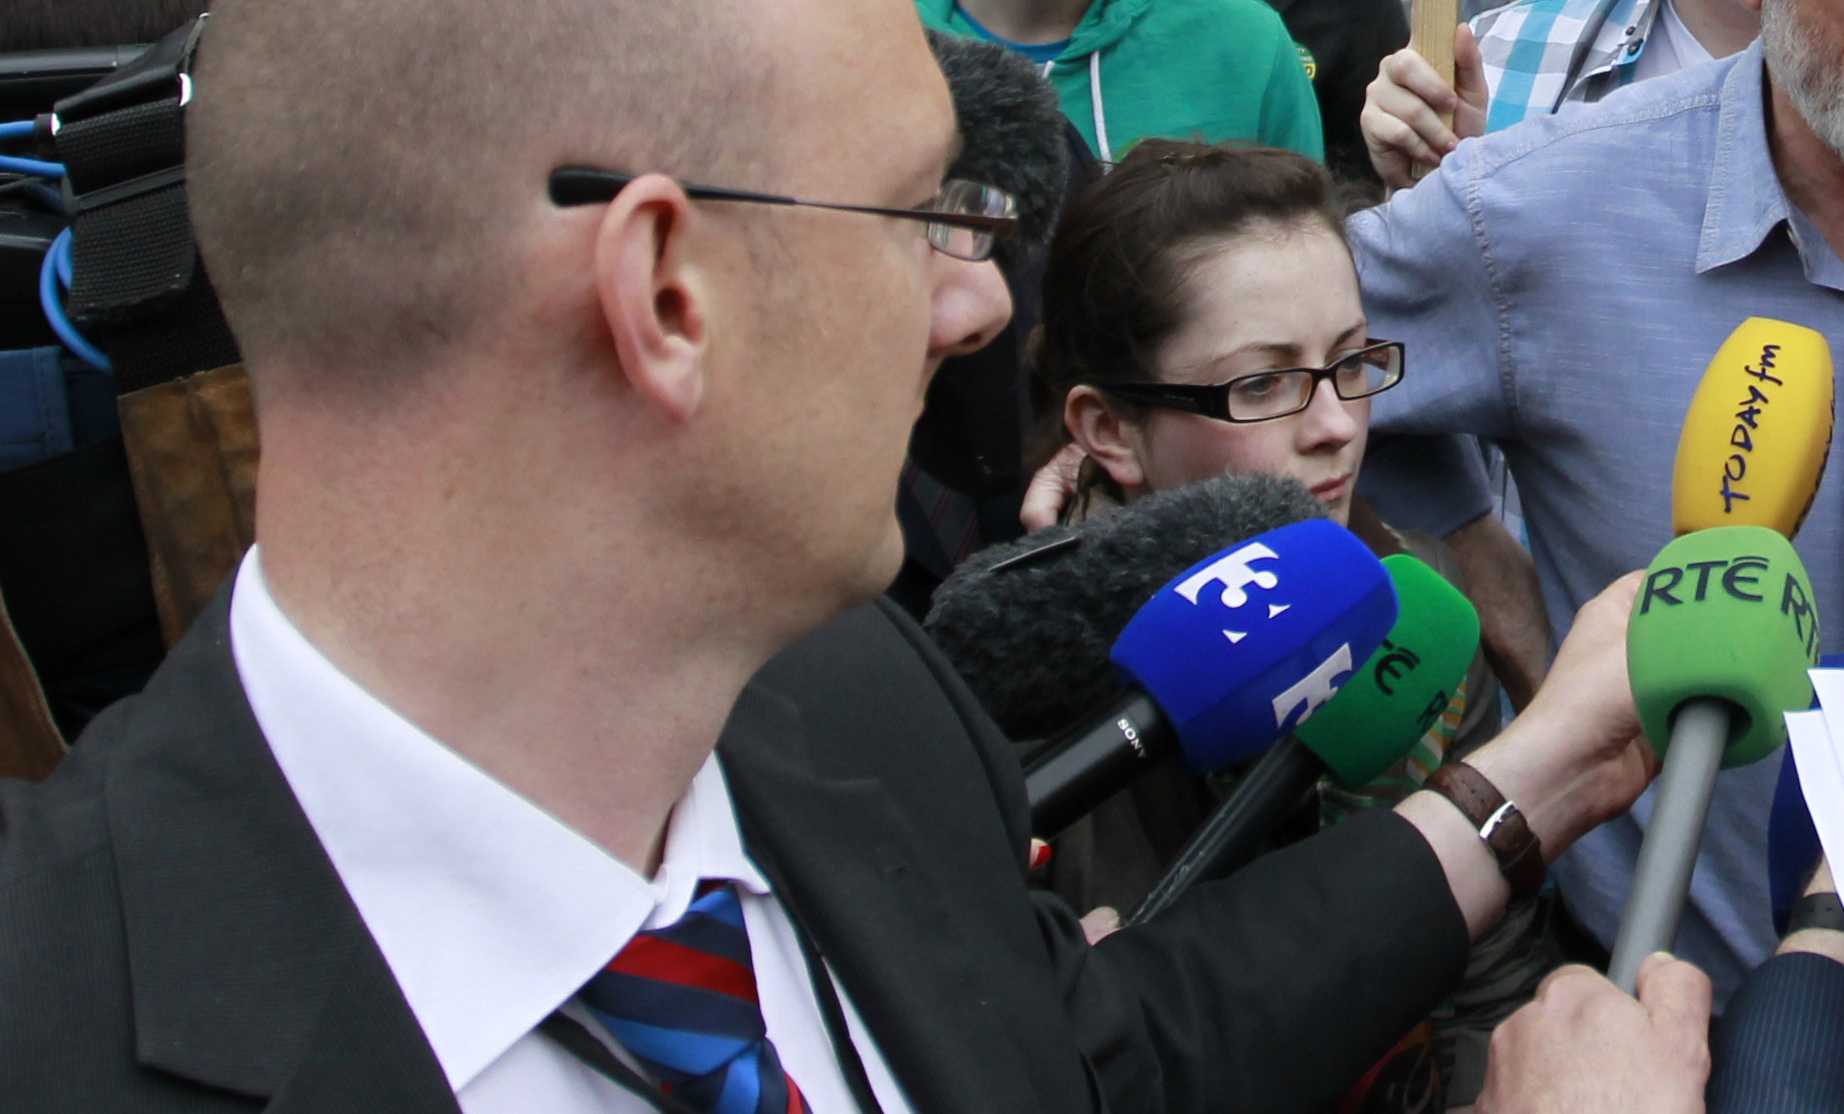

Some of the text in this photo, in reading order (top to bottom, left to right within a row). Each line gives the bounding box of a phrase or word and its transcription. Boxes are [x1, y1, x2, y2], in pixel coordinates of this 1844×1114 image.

[1719, 344, 1783, 513] TODAY fm
[1639, 556, 1770, 617] RTÉ
[1117, 718, 1146, 757] SONY
